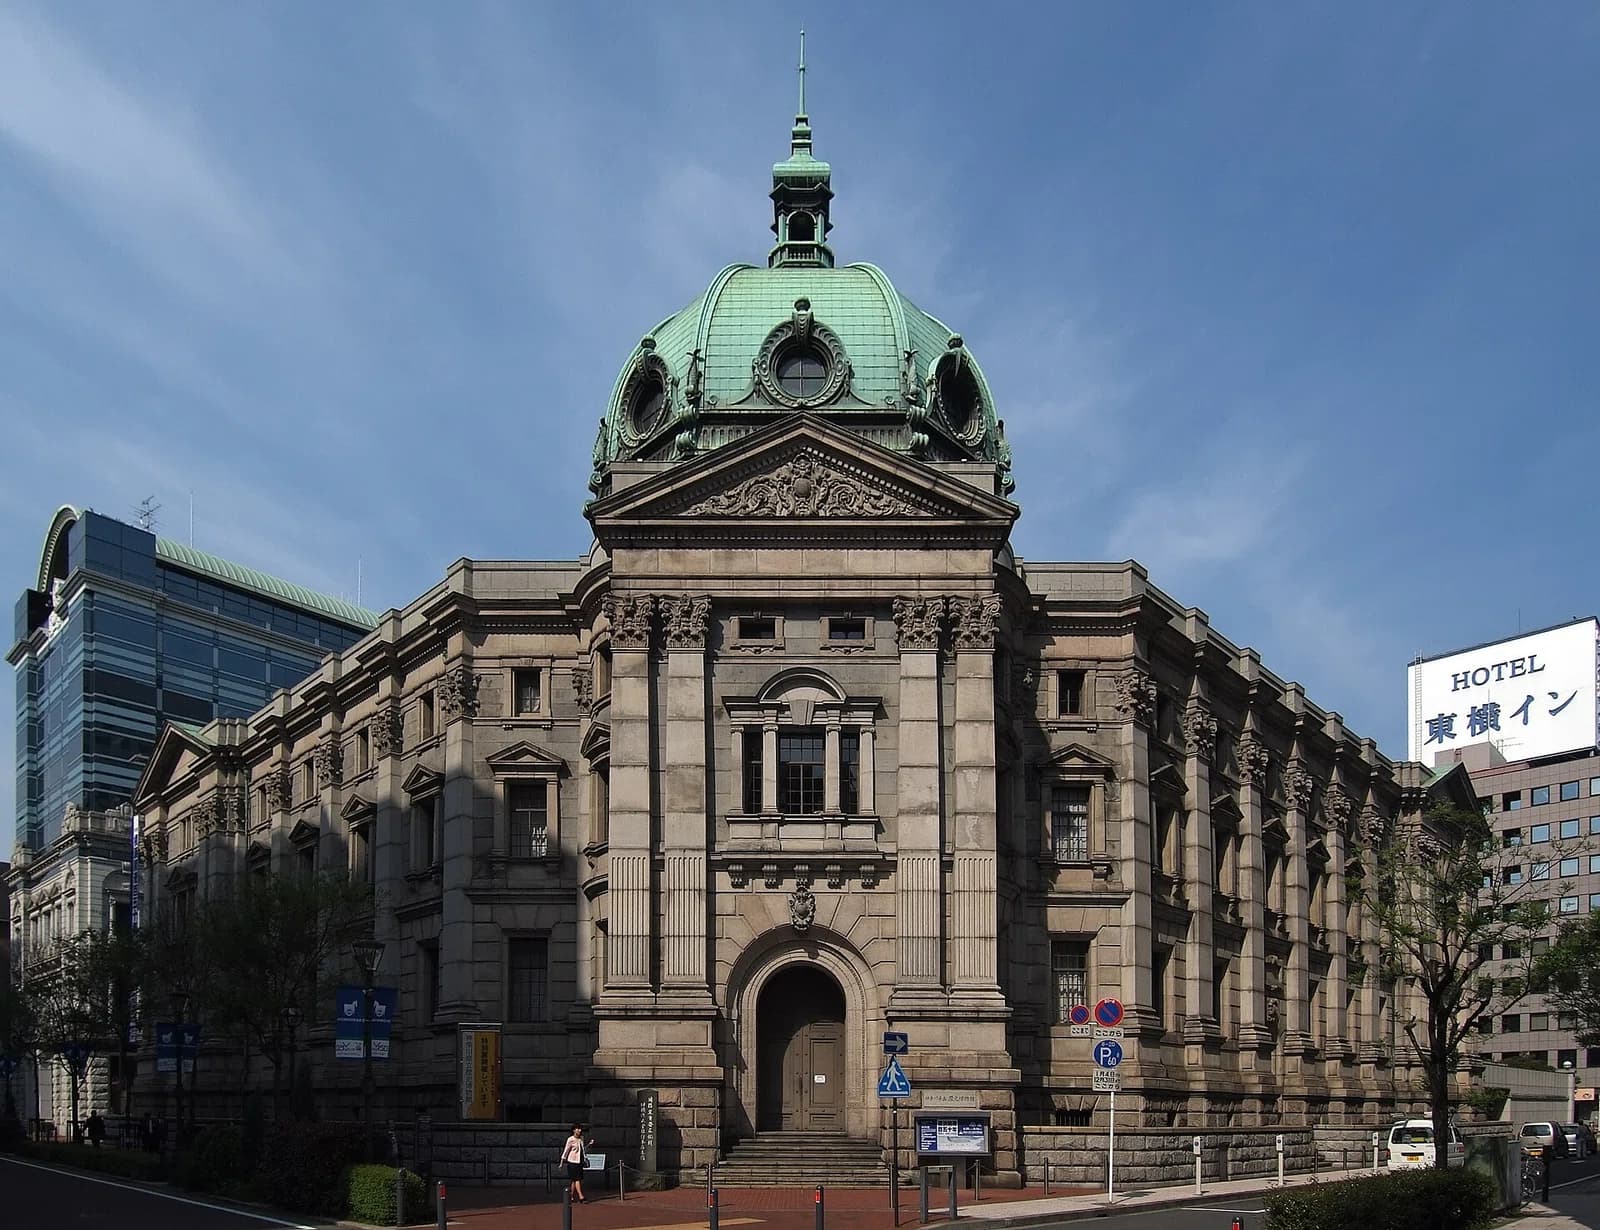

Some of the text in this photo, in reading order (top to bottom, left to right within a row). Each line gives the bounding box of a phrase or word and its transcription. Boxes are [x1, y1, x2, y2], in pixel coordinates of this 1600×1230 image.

[1451, 654, 1546, 692] HOTEL
[1424, 689, 1578, 746] 東横イン
[1096, 1029, 1122, 1037] ここから
[1100, 1047, 1117, 1066] P 60
